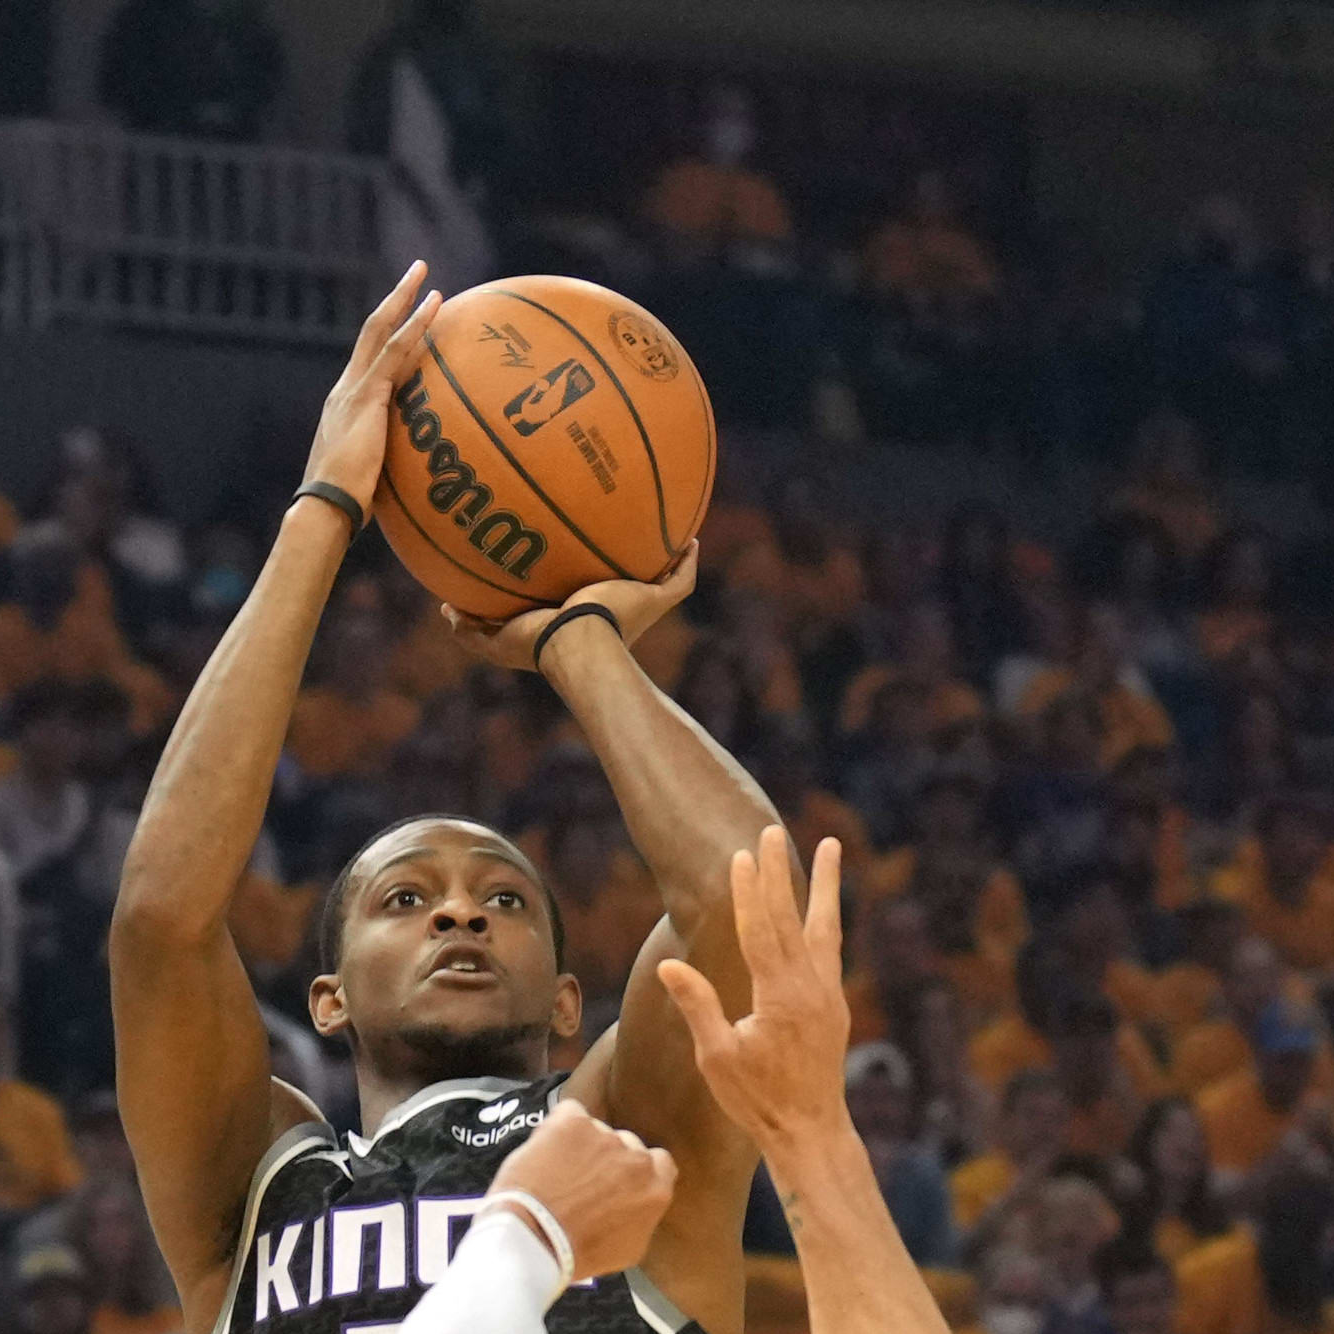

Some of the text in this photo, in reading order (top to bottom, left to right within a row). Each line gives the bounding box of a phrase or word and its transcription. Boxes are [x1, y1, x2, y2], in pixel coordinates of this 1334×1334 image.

[396, 367, 548, 582] Wilson
[451, 1109, 544, 1148] dialpad
[254, 1195, 597, 1324] KIN
